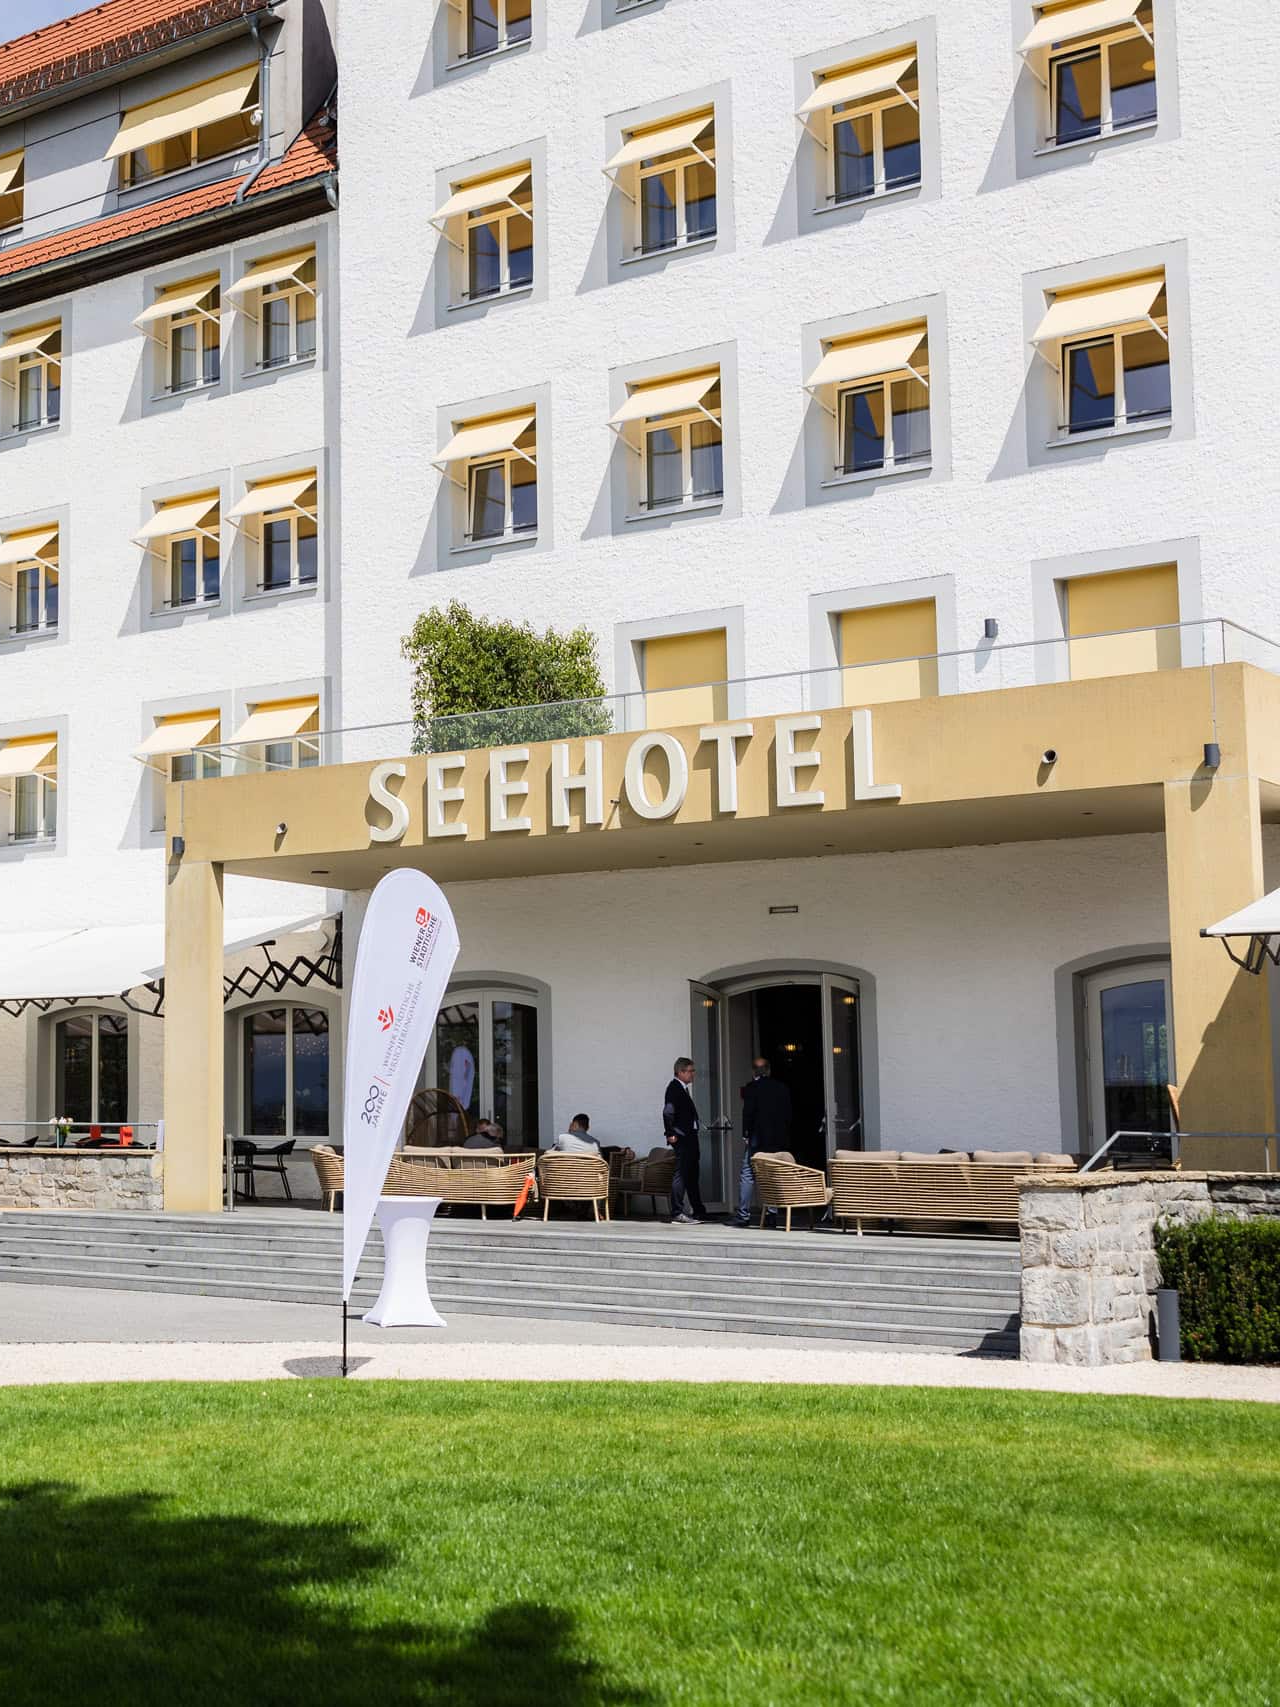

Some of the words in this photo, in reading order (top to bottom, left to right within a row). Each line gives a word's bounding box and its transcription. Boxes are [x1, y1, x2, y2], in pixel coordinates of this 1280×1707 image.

[368, 708, 902, 843] SEEHOTEL
[409, 927, 426, 964] WIENER
[360, 1084, 380, 1125] 200
[371, 1089, 388, 1129] JAHRE
